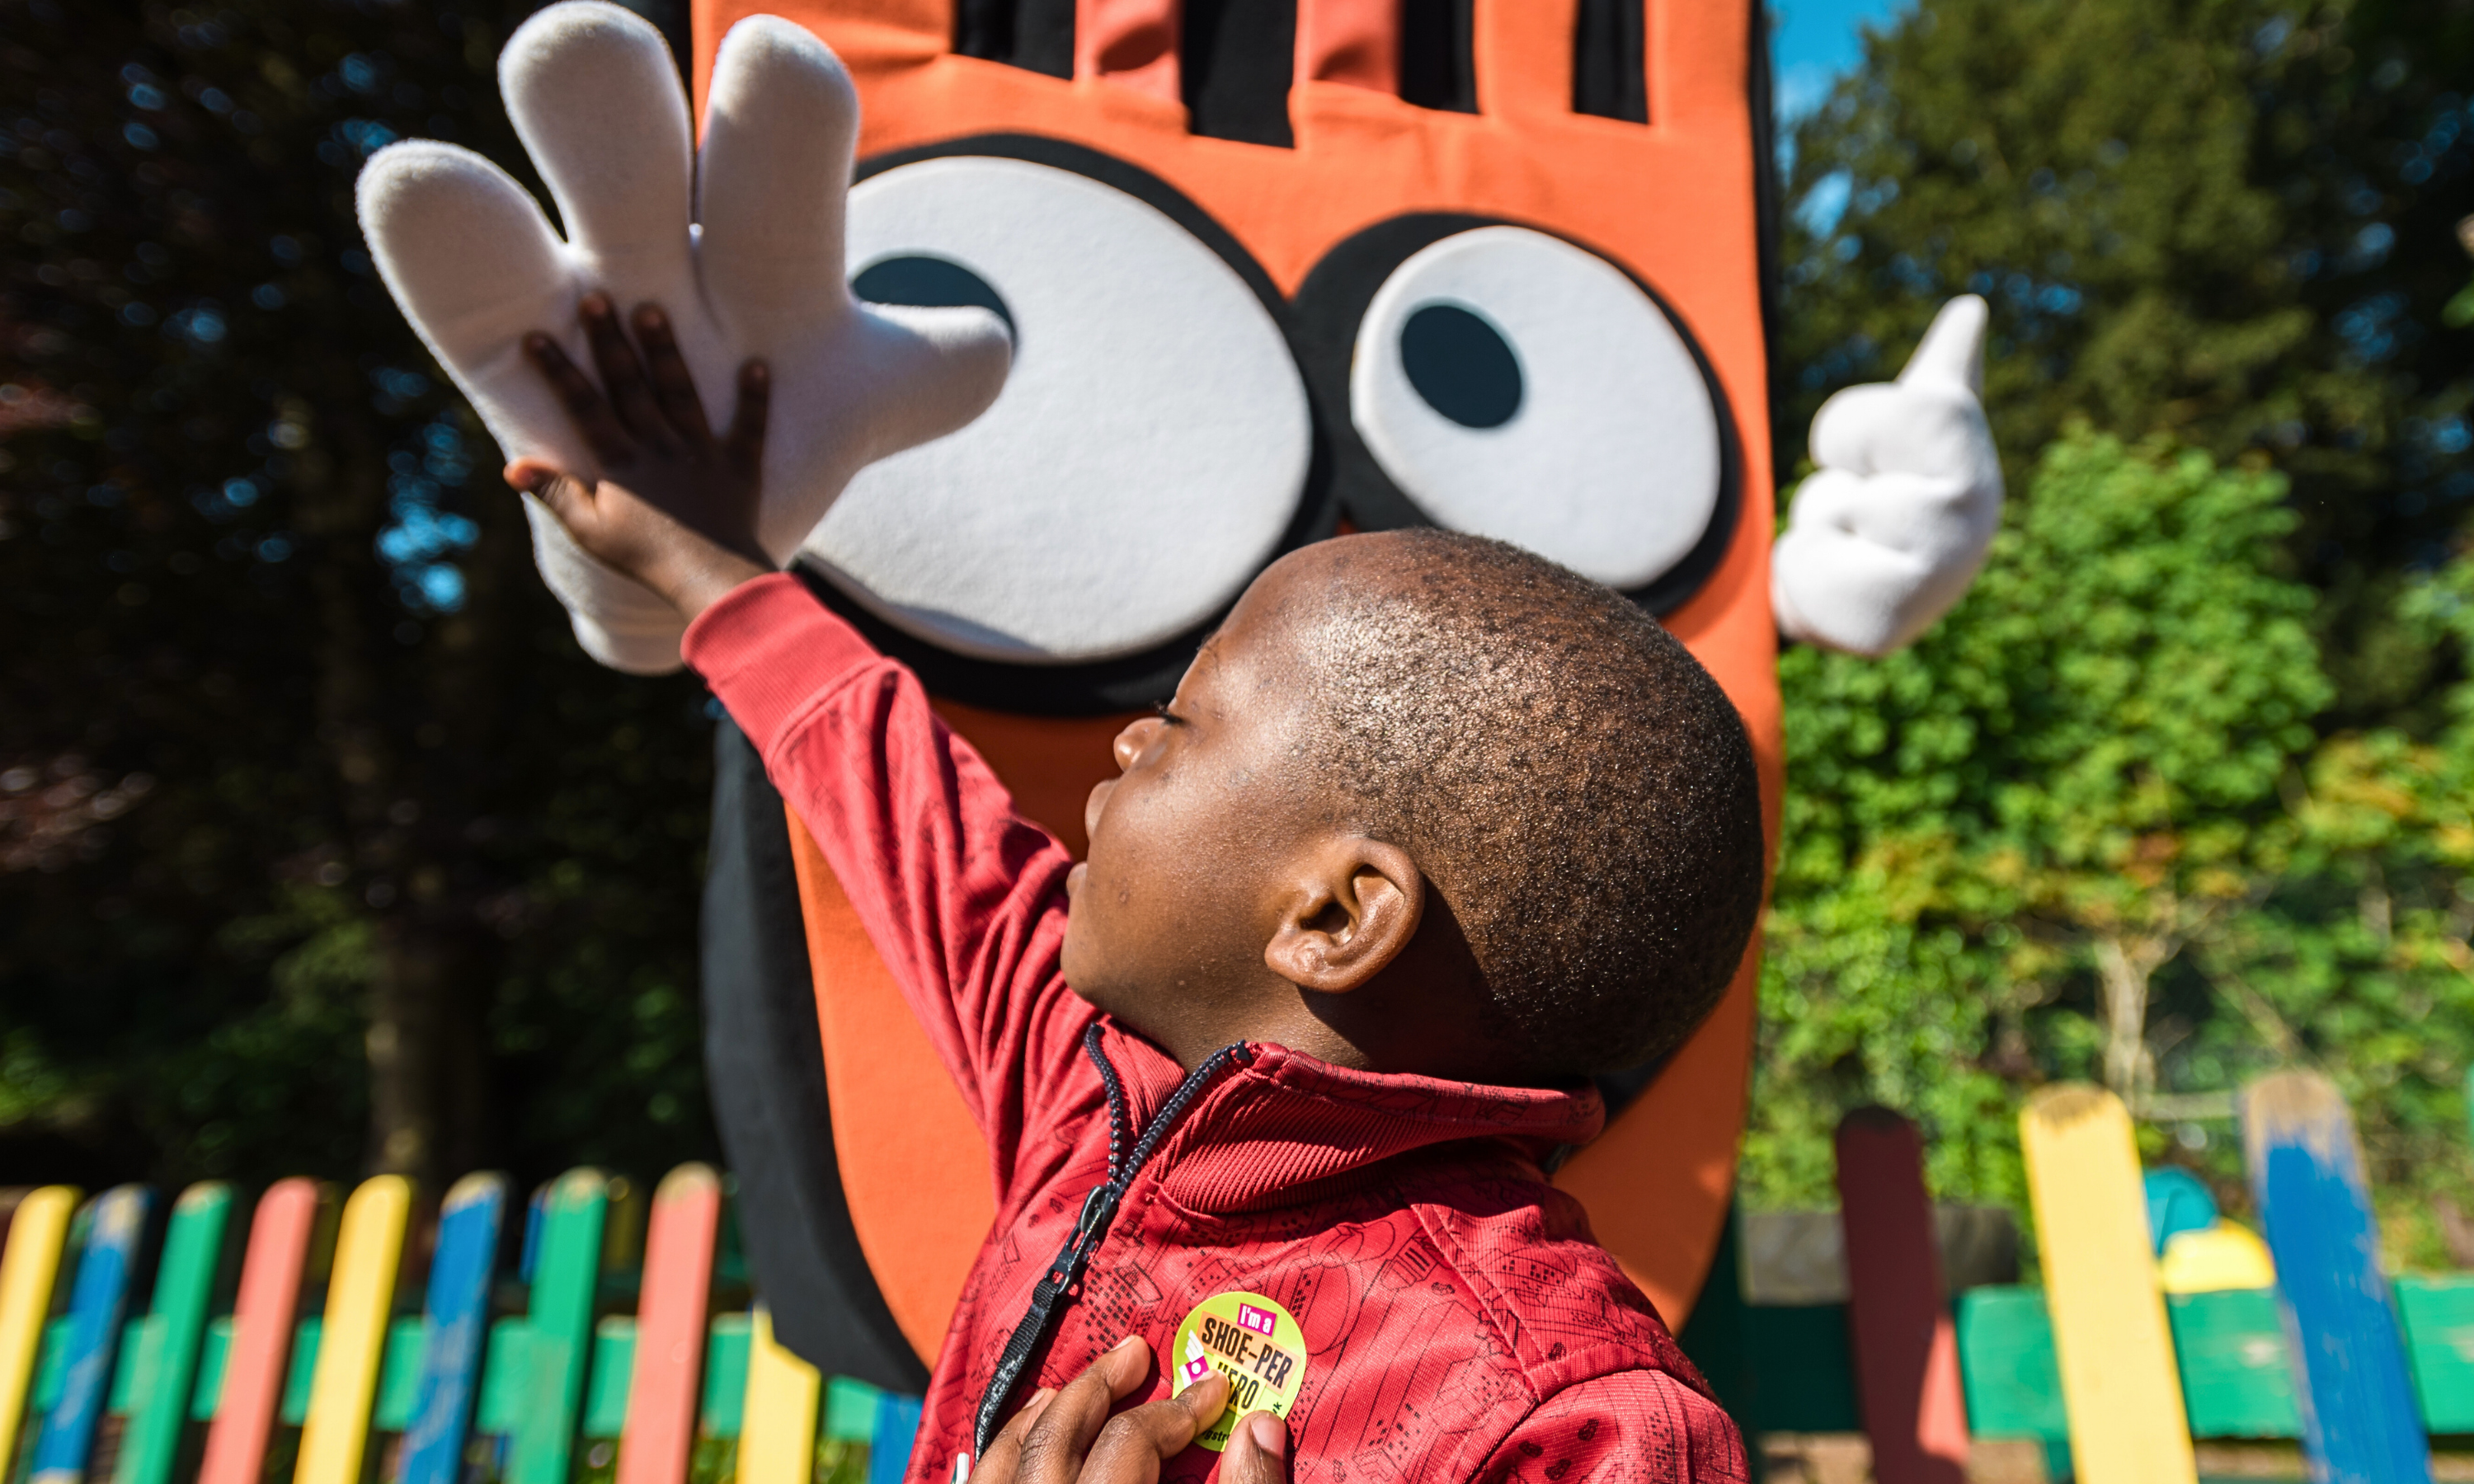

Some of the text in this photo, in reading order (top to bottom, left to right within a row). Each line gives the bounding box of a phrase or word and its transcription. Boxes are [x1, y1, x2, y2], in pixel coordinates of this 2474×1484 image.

[1239, 1305, 1272, 1334] I'm a
[1202, 1317, 1293, 1389] SHOE-PER
